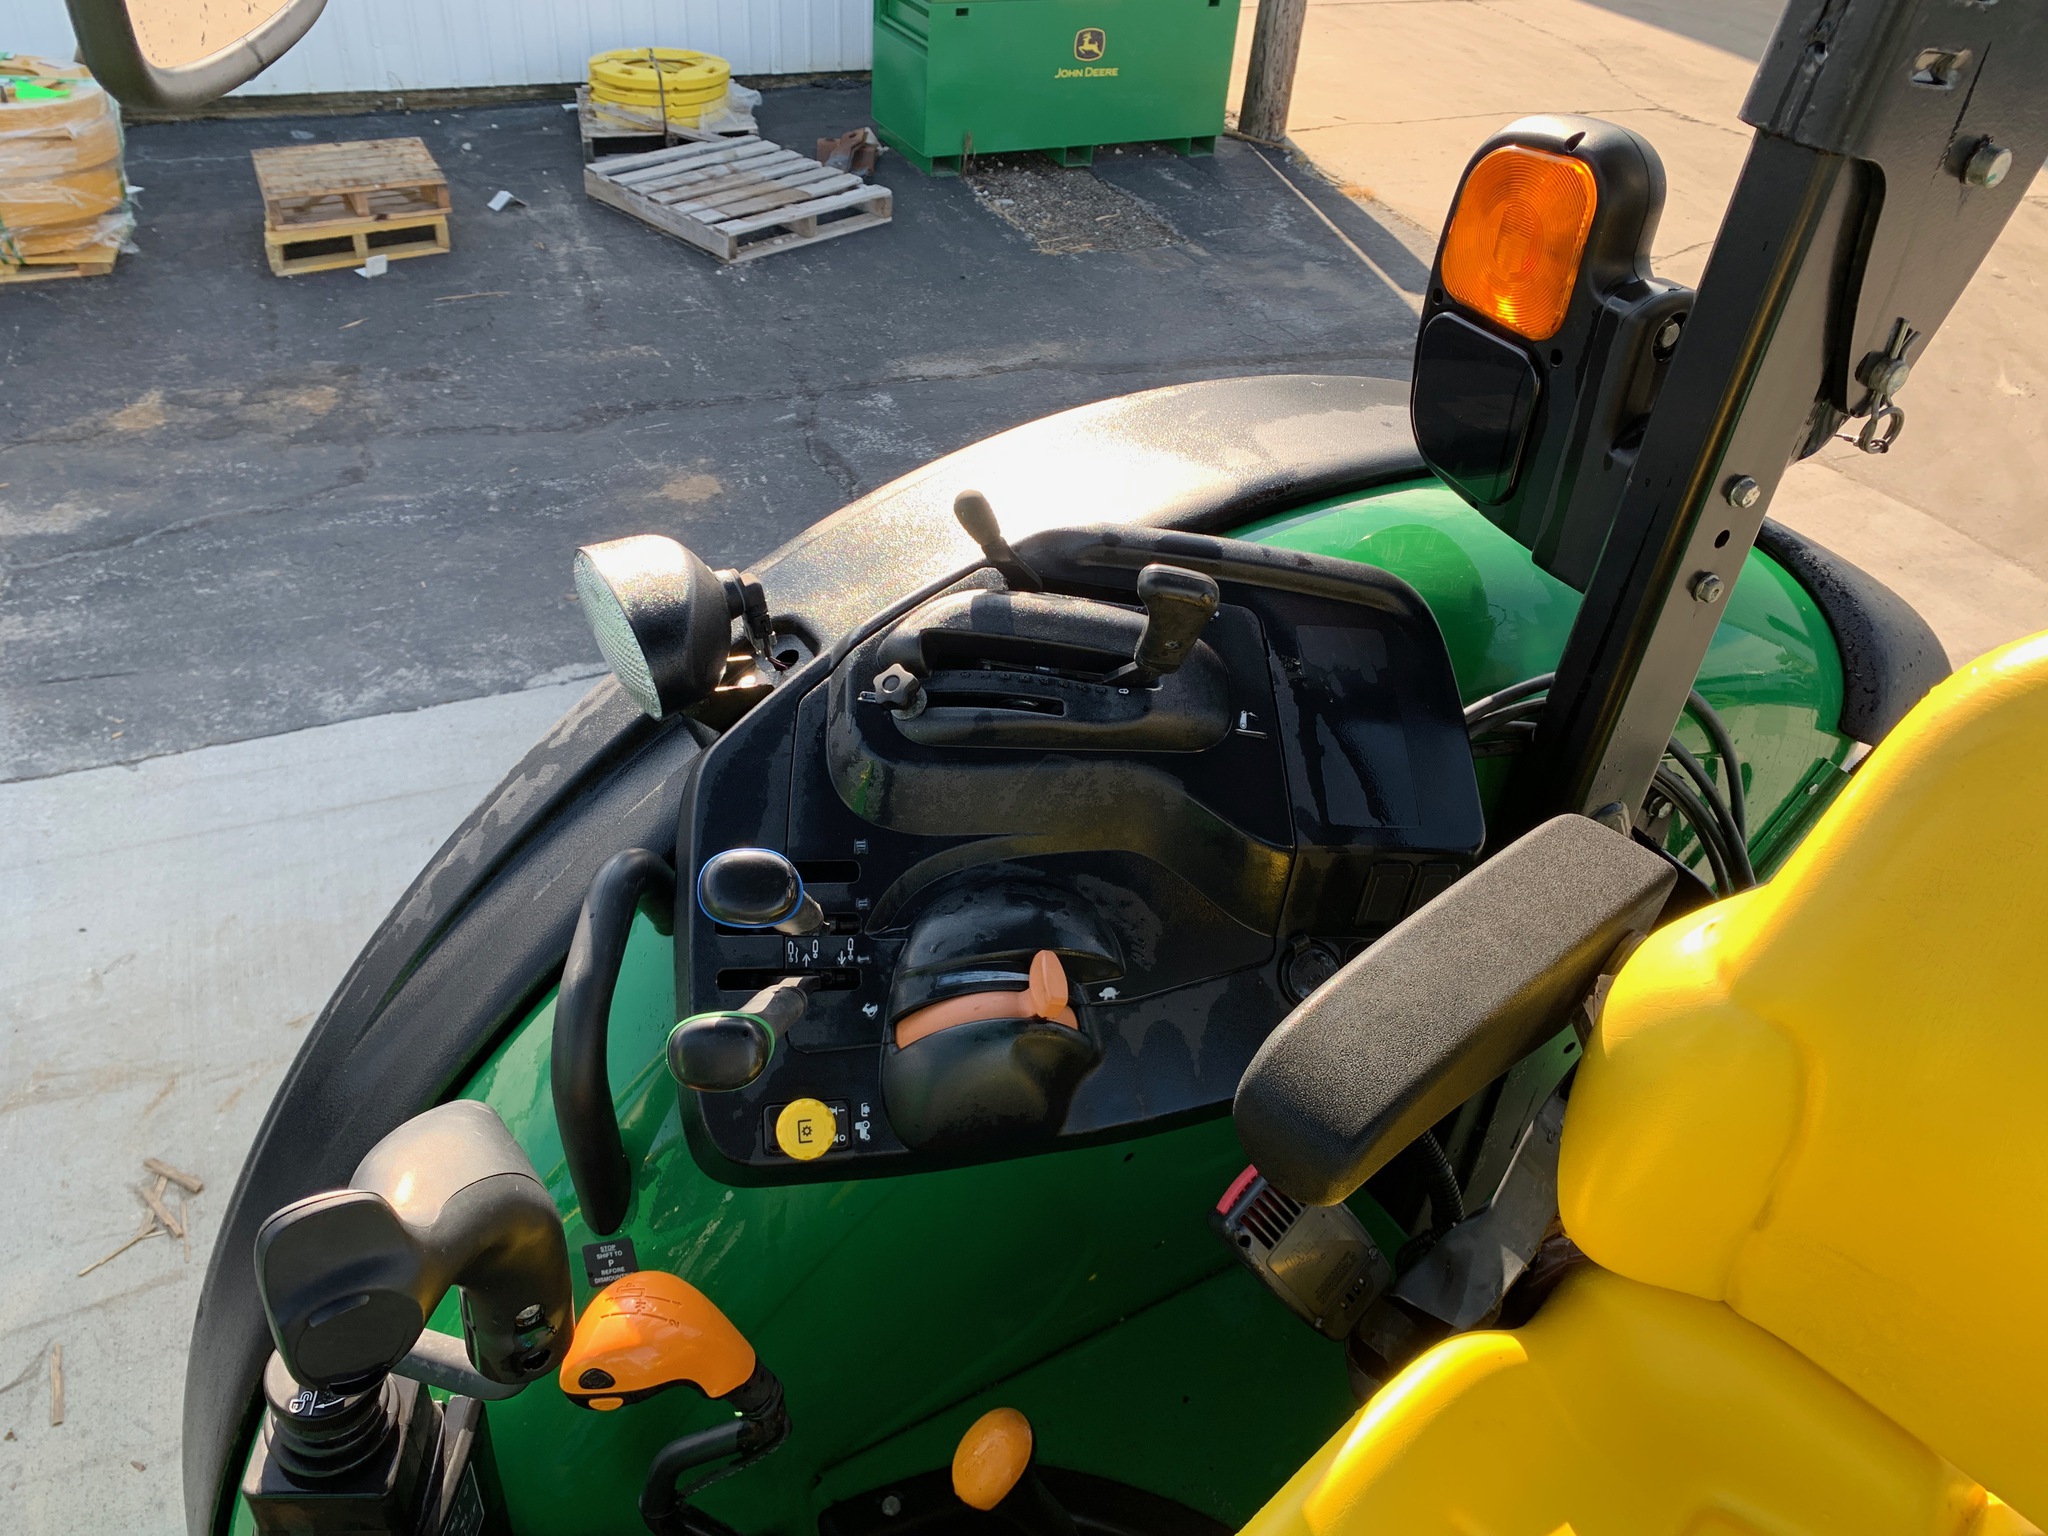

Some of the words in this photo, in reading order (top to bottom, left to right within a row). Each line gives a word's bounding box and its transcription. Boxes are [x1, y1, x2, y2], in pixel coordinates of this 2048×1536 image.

[1055, 67, 1083, 78] JOHN
[1084, 67, 1118, 77] DEERE
[600, 1244, 616, 1253] STOP
[596, 1252, 613, 1260] SHIFT
[608, 1259, 614, 1267] P
[600, 1267, 625, 1276] BEFORE
